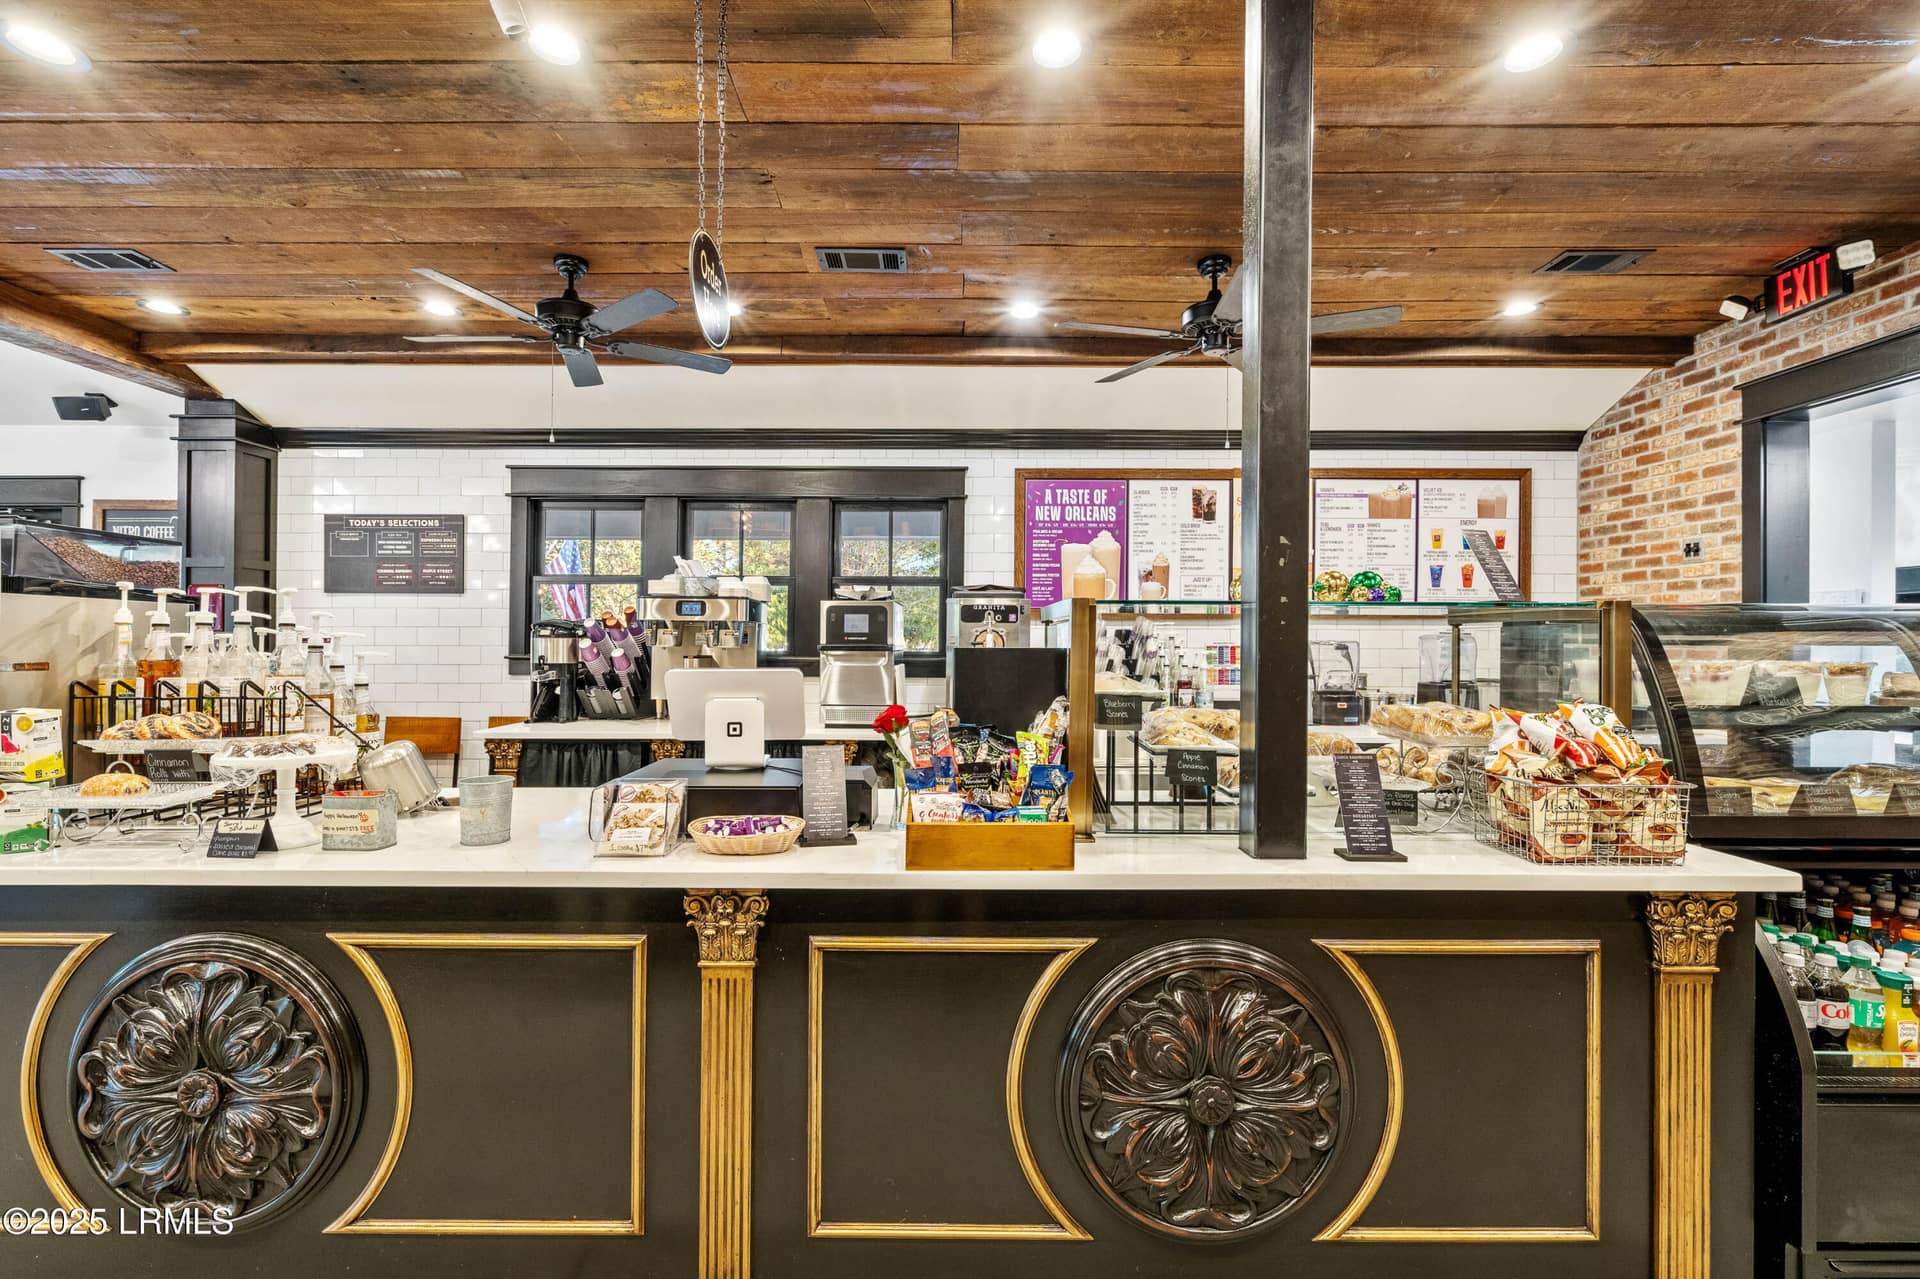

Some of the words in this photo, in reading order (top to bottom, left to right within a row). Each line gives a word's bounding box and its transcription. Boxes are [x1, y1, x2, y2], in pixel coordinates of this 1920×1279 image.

[701, 248, 722, 297] Order
[1776, 252, 1831, 316] EXIT
[1044, 488, 1052, 505] A
[1055, 488, 1091, 505] TASTE
[1093, 488, 1108, 505] OF
[1035, 505, 1061, 521] NEW
[1065, 505, 1117, 521] ORLEANS
[348, 519, 386, 527] TODAY'S
[387, 519, 440, 527] SELECTIONS
[143, 525, 177, 539] COFFEE
[1103, 698, 1136, 709] Blueberry
[1105, 710, 1129, 718] Scones
[147, 752, 190, 767] Cinnamon
[1182, 752, 1201, 761] Apple
[1177, 761, 1210, 771] Cinnamon
[1181, 773, 1206, 783] Scones
